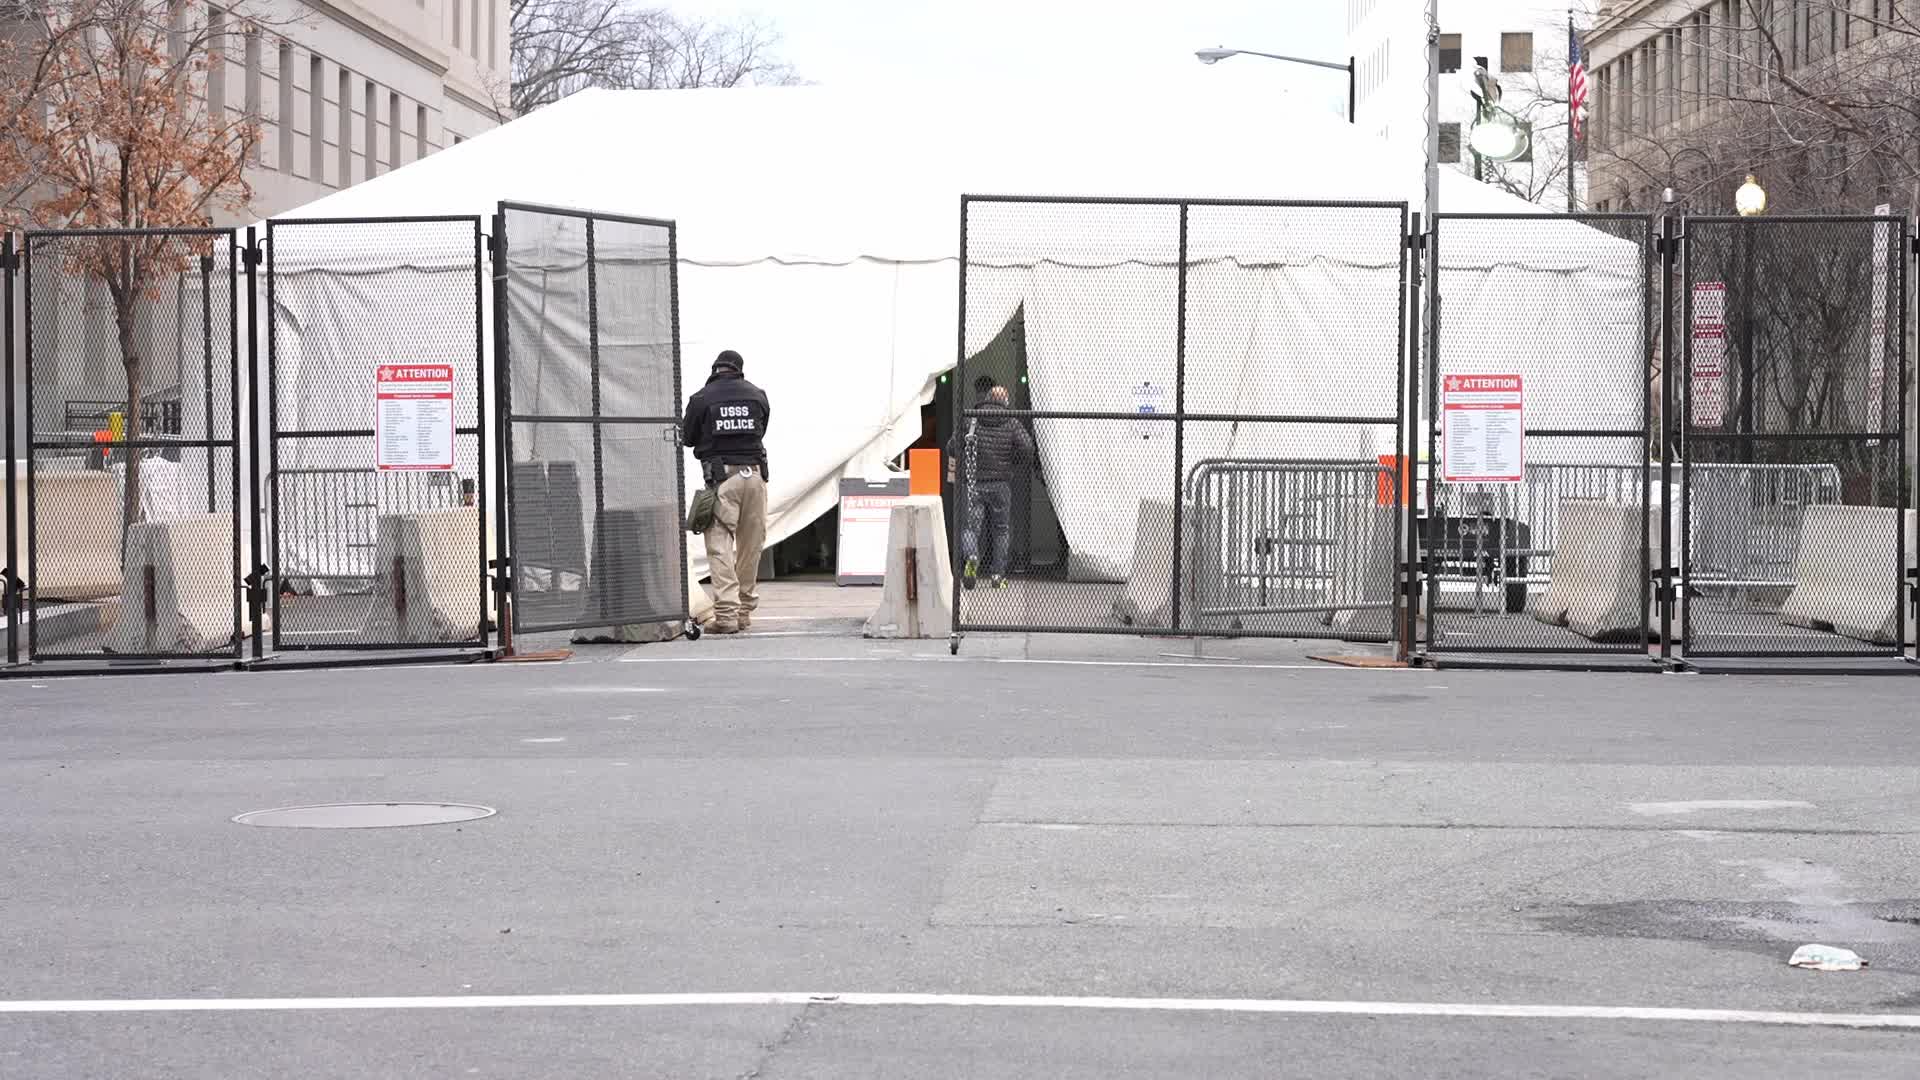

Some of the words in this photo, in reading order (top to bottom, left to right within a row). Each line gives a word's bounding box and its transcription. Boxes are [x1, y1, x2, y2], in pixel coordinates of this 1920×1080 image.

[395, 368, 448, 378] ATTENTION
[1463, 378, 1518, 388] ATTENTION
[720, 406, 749, 417] USSS
[715, 419, 755, 431] POLICE
